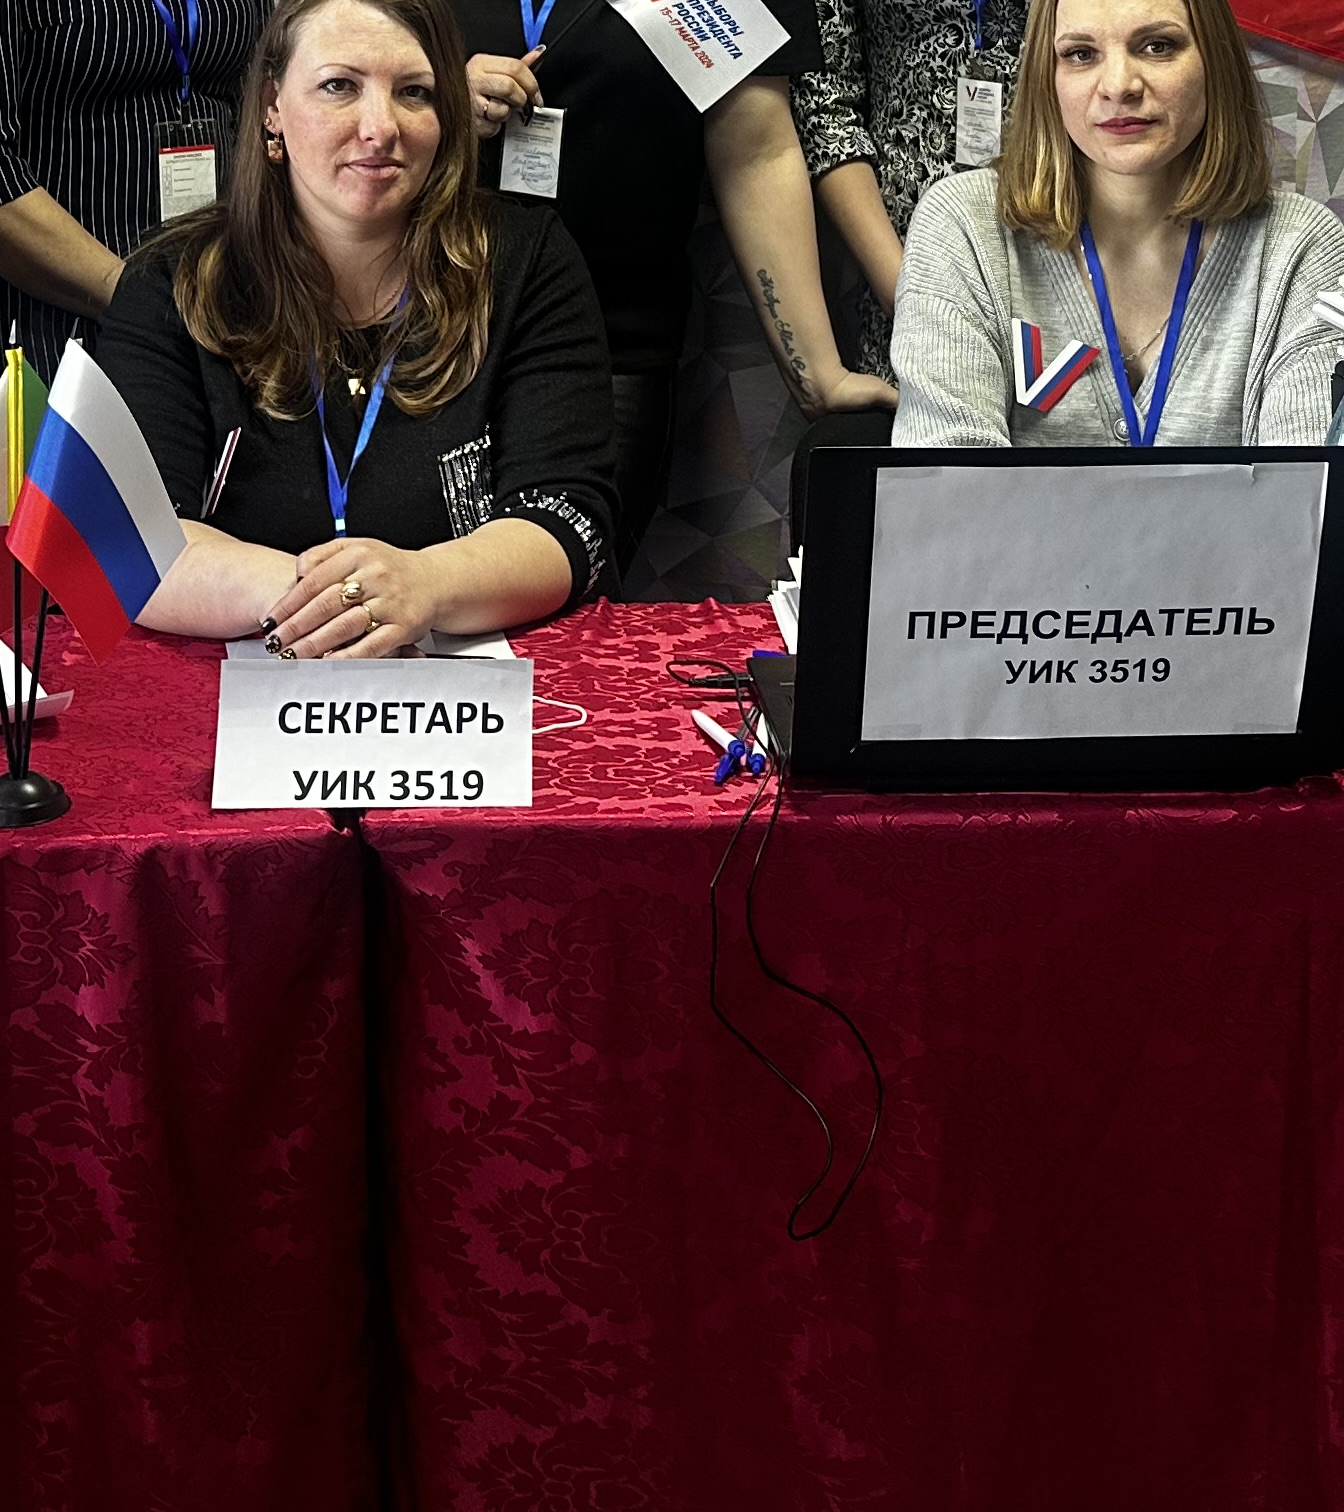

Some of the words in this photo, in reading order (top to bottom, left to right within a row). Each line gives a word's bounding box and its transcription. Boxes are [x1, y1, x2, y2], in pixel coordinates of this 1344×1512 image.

[672, 2, 711, 42] РОССИИ
[675, 25, 700, 52] МАРТА
[907, 606, 1276, 645] ПРЕДСЕДАТЕЛЬ
[1004, 659, 1079, 687] УИК
[1088, 657, 1172, 684] 3519
[278, 701, 505, 735] СЕКРЕТАРЬ
[293, 770, 376, 801] УИК
[389, 770, 485, 801] 3519
